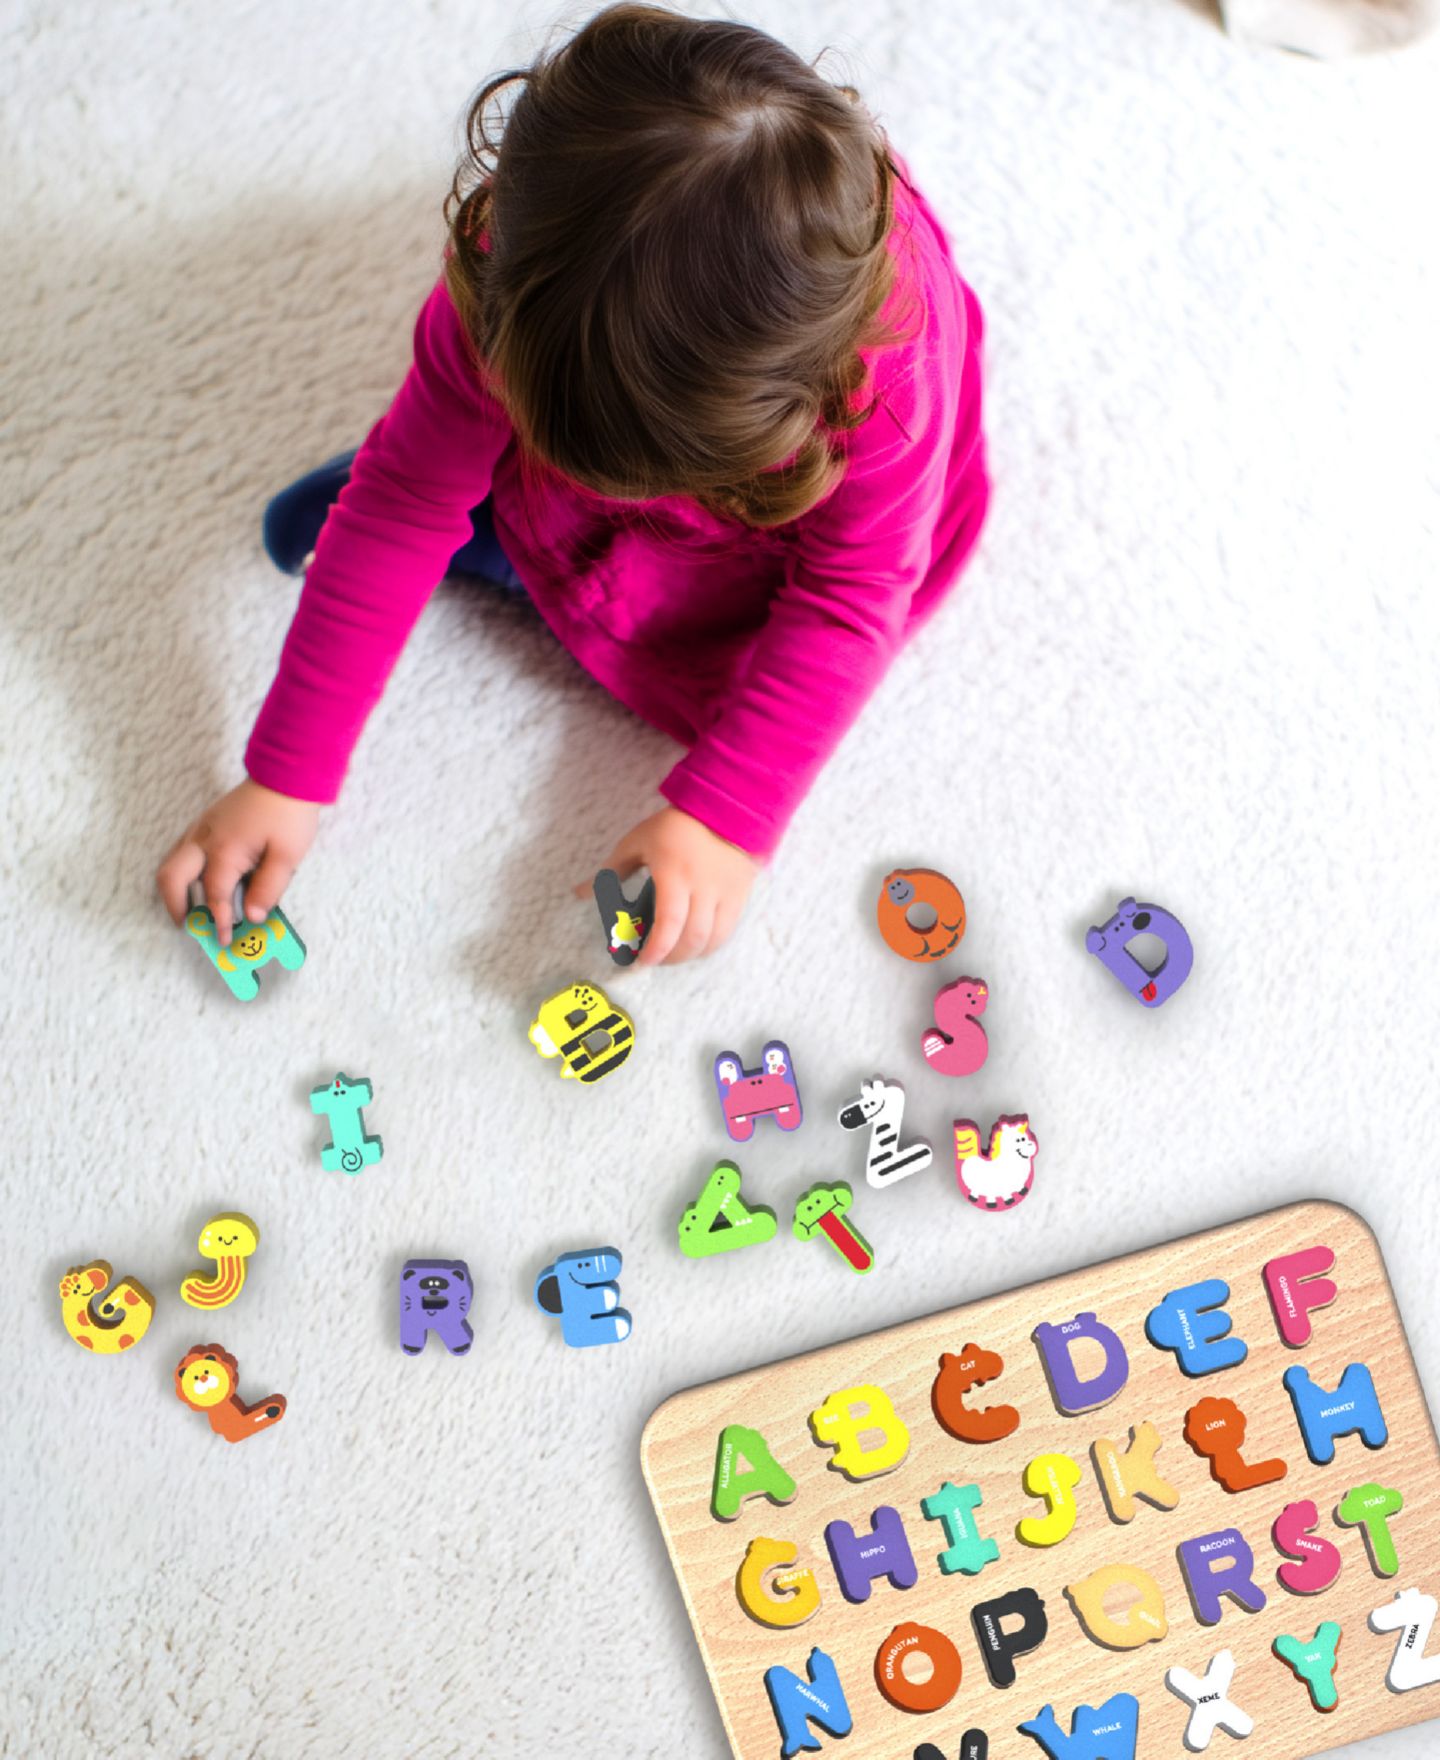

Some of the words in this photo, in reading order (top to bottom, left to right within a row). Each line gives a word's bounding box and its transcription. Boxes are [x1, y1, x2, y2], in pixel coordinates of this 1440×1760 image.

[877, 868, 966, 963] O
[1085, 896, 1193, 1008] D
[528, 980, 635, 1084] B
[921, 975, 989, 1077] S
[714, 1040, 803, 1142] H
[838, 1074, 932, 1188] Z
[400, 1259, 473, 1356] R
[534, 1246, 632, 1348] E
[1062, 1322, 1081, 1334] DOG
[1145, 1279, 1248, 1379] E
[1177, 1308, 1195, 1350] ELEPHANT
[1262, 1246, 1337, 1349] F
[1278, 1275, 1297, 1318] FLAMINGO
[931, 1343, 1020, 1444] C
[960, 1359, 976, 1371] CAT
[1031, 1312, 1129, 1417] D
[1320, 1401, 1355, 1418] MONKEY
[807, 1384, 910, 1483] B
[1183, 1397, 1288, 1494] L
[1205, 1418, 1226, 1431] LION
[1283, 1362, 1388, 1466] M
[711, 1424, 797, 1523] A
[721, 1442, 733, 1489] ALLIGATOR
[1016, 1453, 1081, 1547] J
[1089, 1421, 1180, 1525] K
[1362, 1495, 1387, 1508] TOAD
[824, 1505, 918, 1604] H
[860, 1545, 886, 1559] HIPPO
[920, 1481, 1000, 1575] I
[1200, 1537, 1235, 1553] RACOON
[1271, 1500, 1341, 1596] S
[1296, 1539, 1323, 1553] SNAKE
[1333, 1482, 1403, 1578] T
[736, 1536, 822, 1630] G
[1062, 1563, 1168, 1651] Q
[1176, 1528, 1266, 1626] R
[874, 1622, 962, 1714] O
[971, 1587, 1048, 1689] P
[983, 1614, 1000, 1651] PENGUIN
[1271, 1621, 1342, 1713] Y
[1368, 1588, 1440, 1694] Z
[1405, 1624, 1420, 1650] ZEBRA
[764, 1647, 853, 1760] N
[795, 1683, 831, 1713] NARWHAL
[1092, 1721, 1122, 1737] WHALE
[1165, 1650, 1253, 1751] X
[1198, 1692, 1220, 1705] XEME
